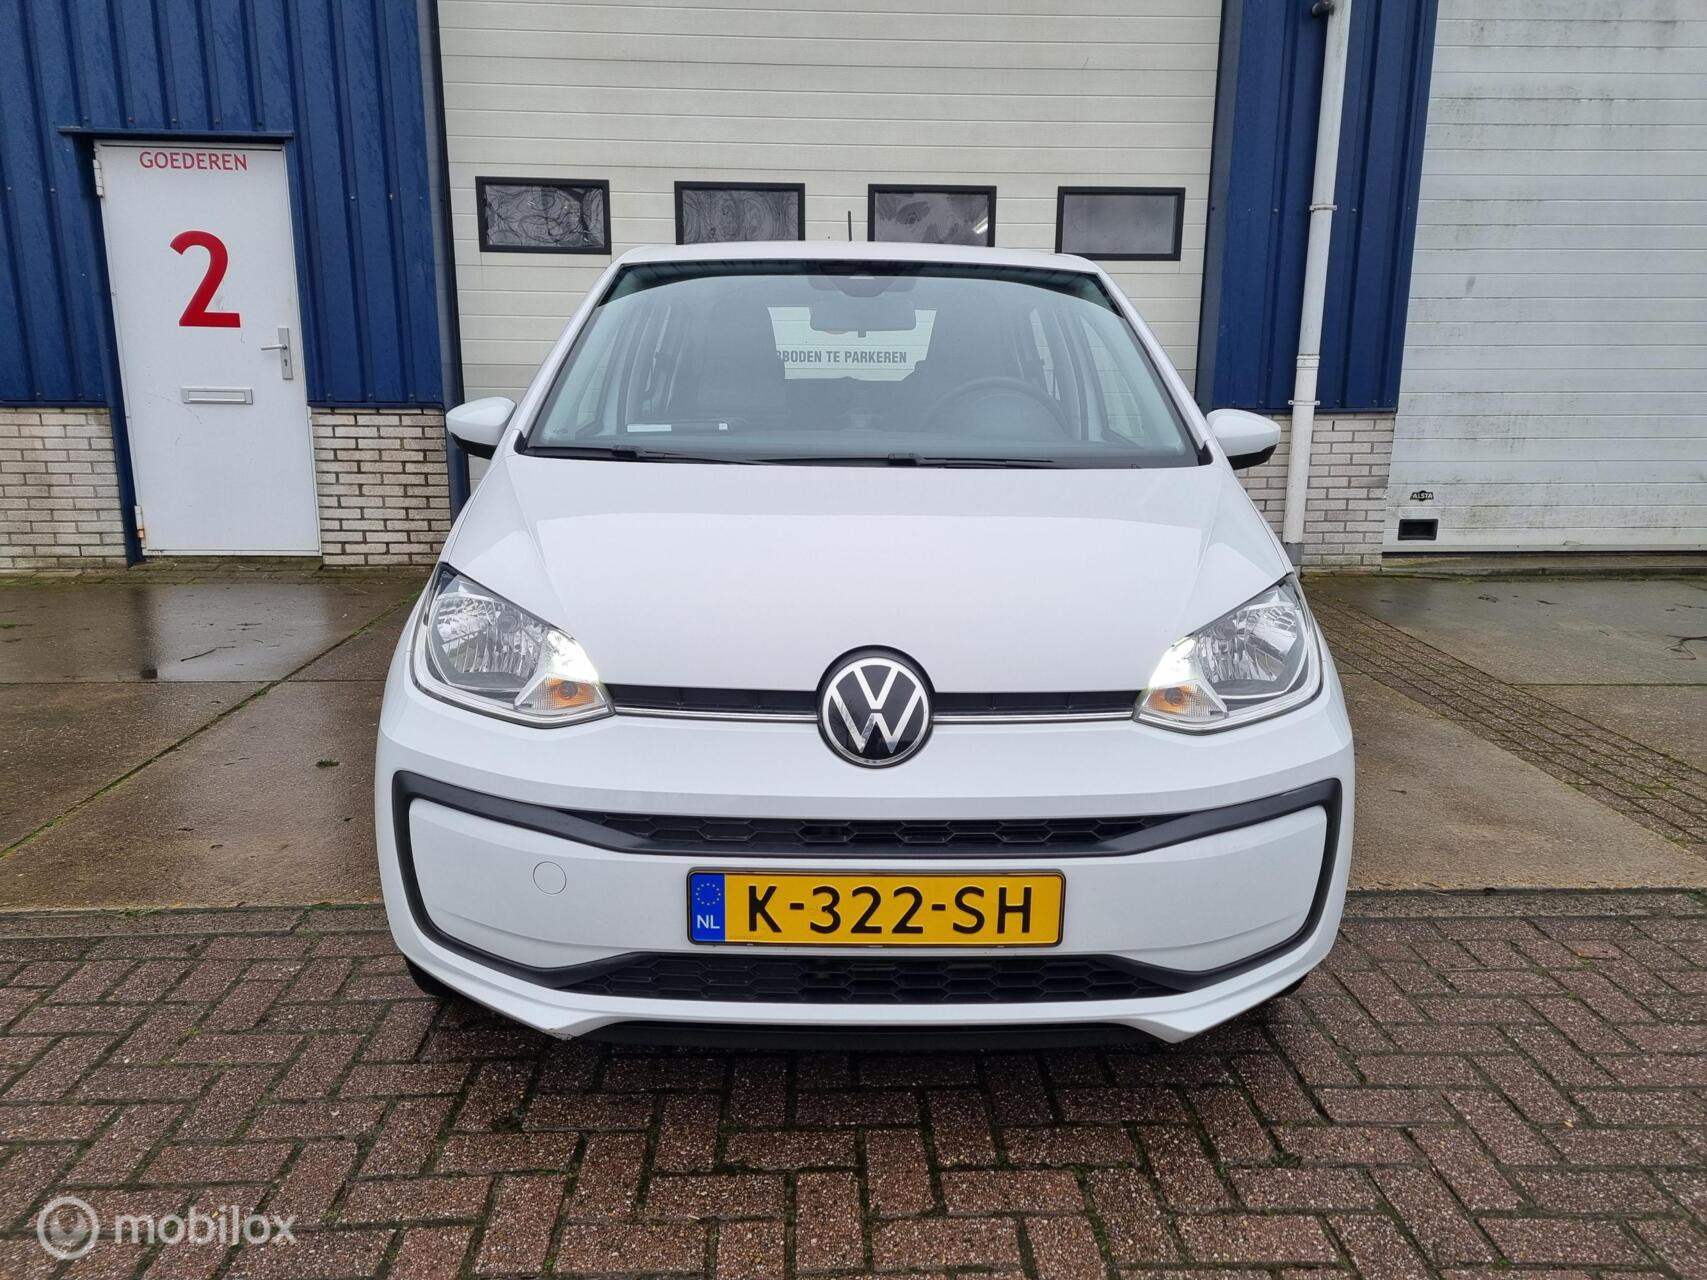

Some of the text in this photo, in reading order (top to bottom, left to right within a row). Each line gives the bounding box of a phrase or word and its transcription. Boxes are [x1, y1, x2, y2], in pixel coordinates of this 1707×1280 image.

[139, 151, 248, 170] GOEDEREN
[170, 230, 241, 328] 2
[826, 351, 840, 363] TE
[844, 351, 907, 363] PARKEREN
[748, 885, 1032, 934] K-322-SH
[696, 914, 720, 929] NL
